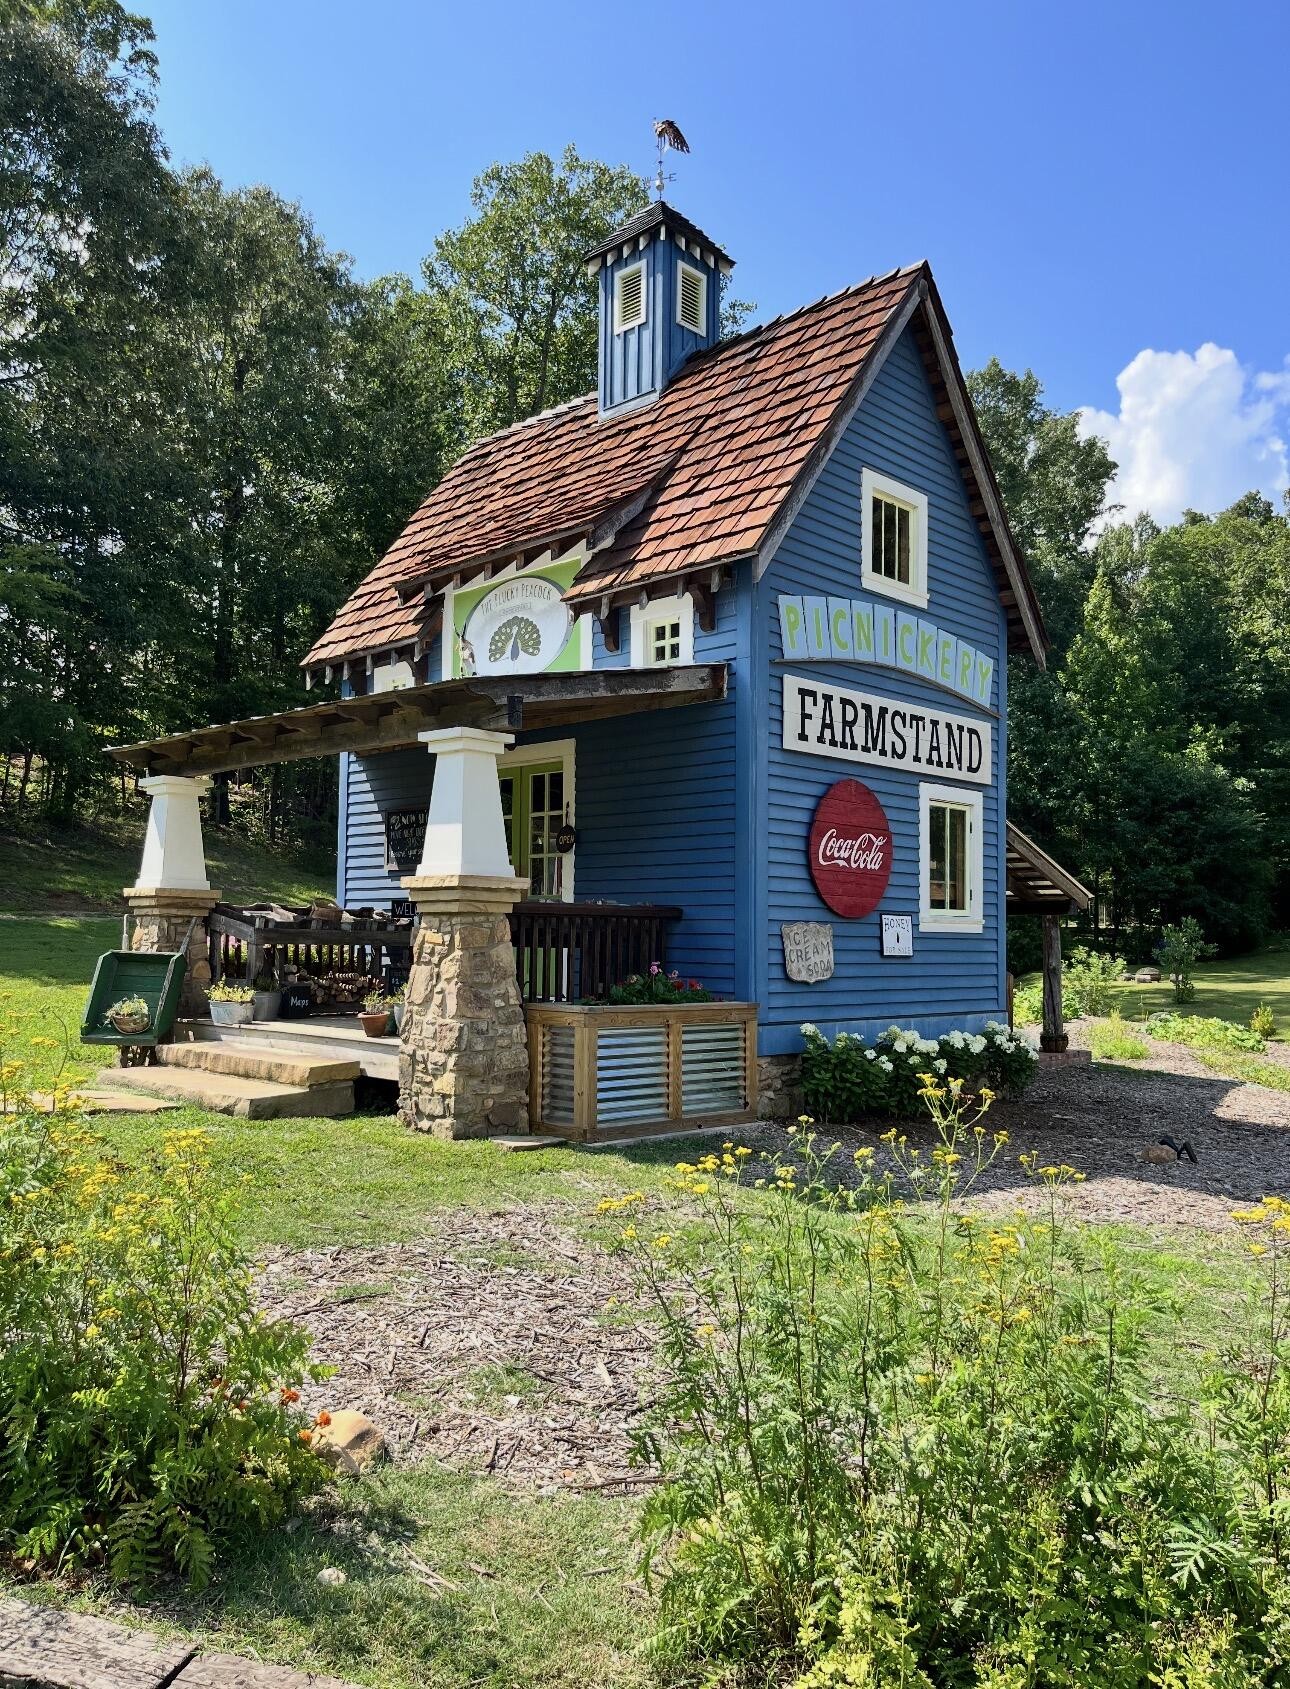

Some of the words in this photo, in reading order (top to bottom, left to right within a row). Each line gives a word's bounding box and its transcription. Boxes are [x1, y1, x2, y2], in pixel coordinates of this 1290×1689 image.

[481, 599, 492, 615] THE
[494, 586, 519, 607] PLUCKY
[521, 583, 552, 600] PEACOCK
[785, 604, 992, 699] PICNICKERY
[797, 687, 983, 774] FARMSTAND
[559, 835, 575, 845] OPEN
[883, 917, 911, 933] HONEY
[787, 928, 810, 947] ICE
[788, 941, 831, 964] CREAM
[897, 946, 911, 954] SALE
[807, 959, 832, 977] SODA
[290, 995, 309, 1008] Maps
